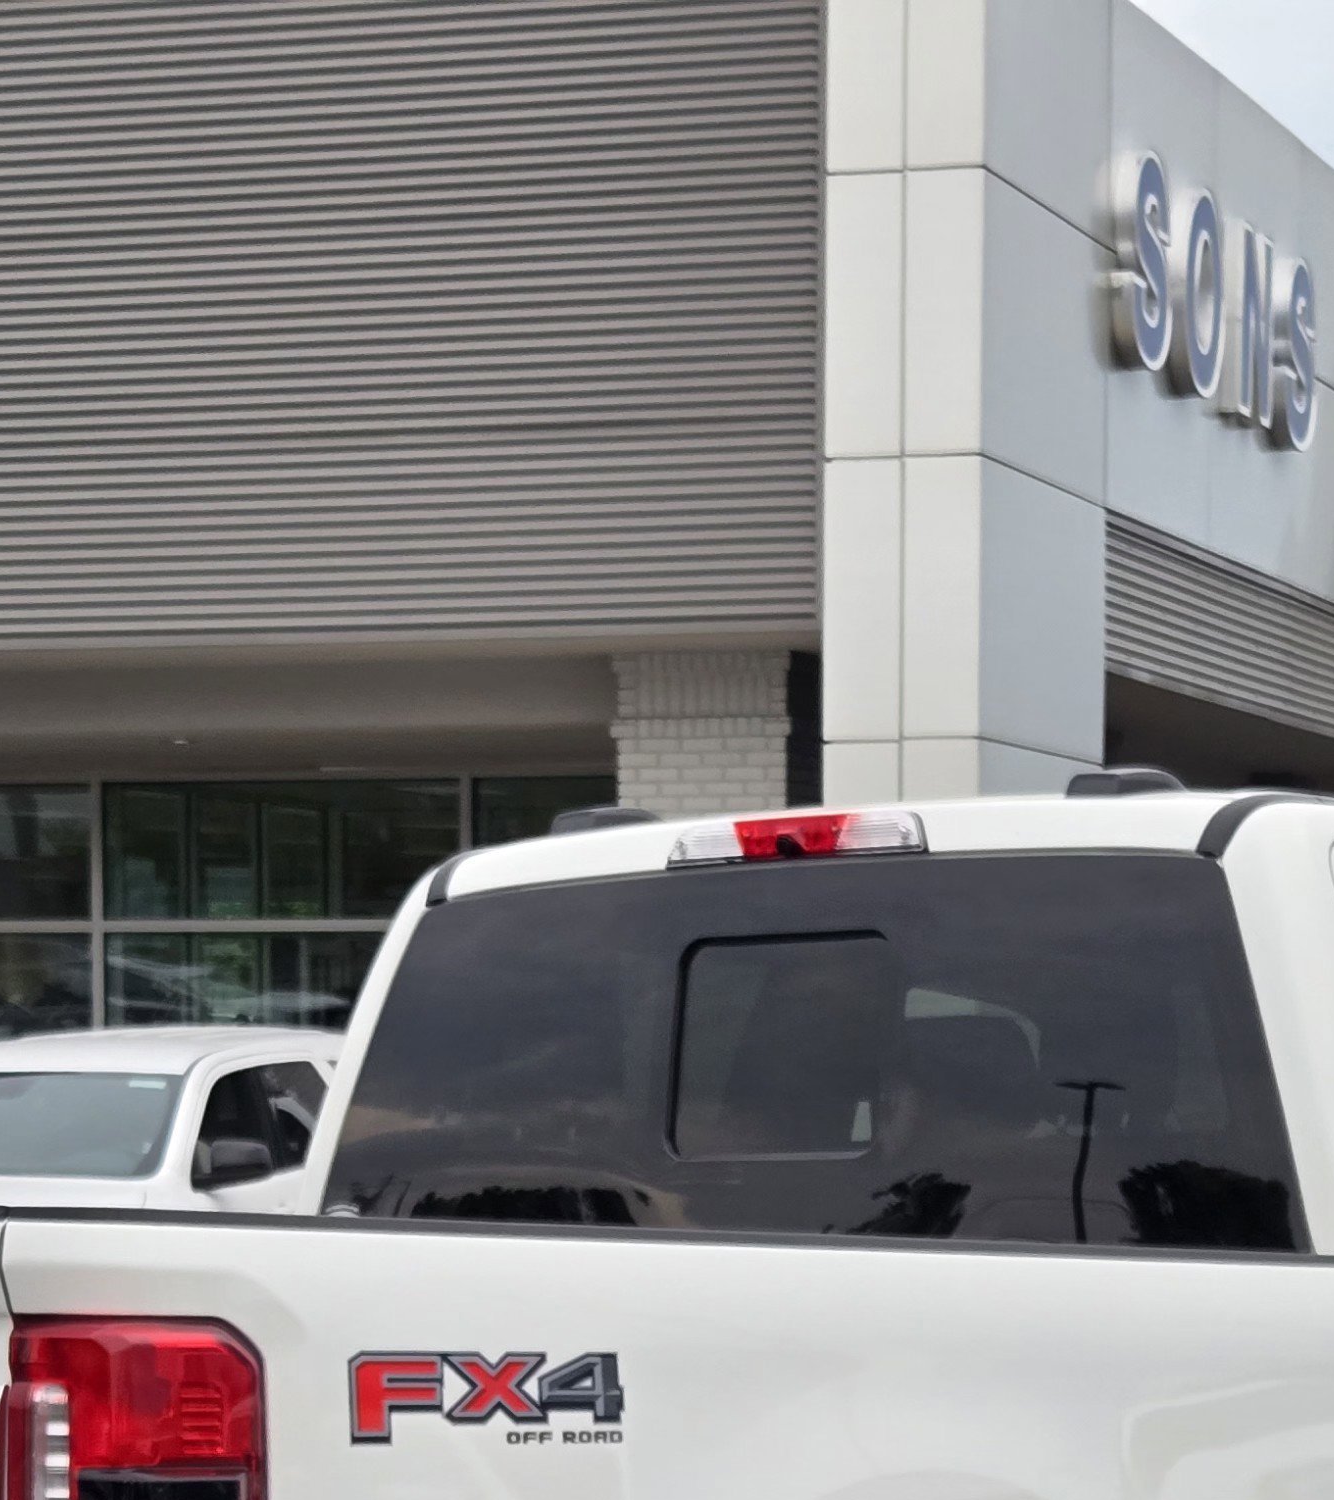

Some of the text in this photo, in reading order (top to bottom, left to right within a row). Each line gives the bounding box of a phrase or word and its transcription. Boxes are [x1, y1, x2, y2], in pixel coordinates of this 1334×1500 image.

[1129, 150, 1317, 452] SONS
[348, 1350, 624, 1445] FX4
[506, 1430, 623, 1445] OFF ROAD
